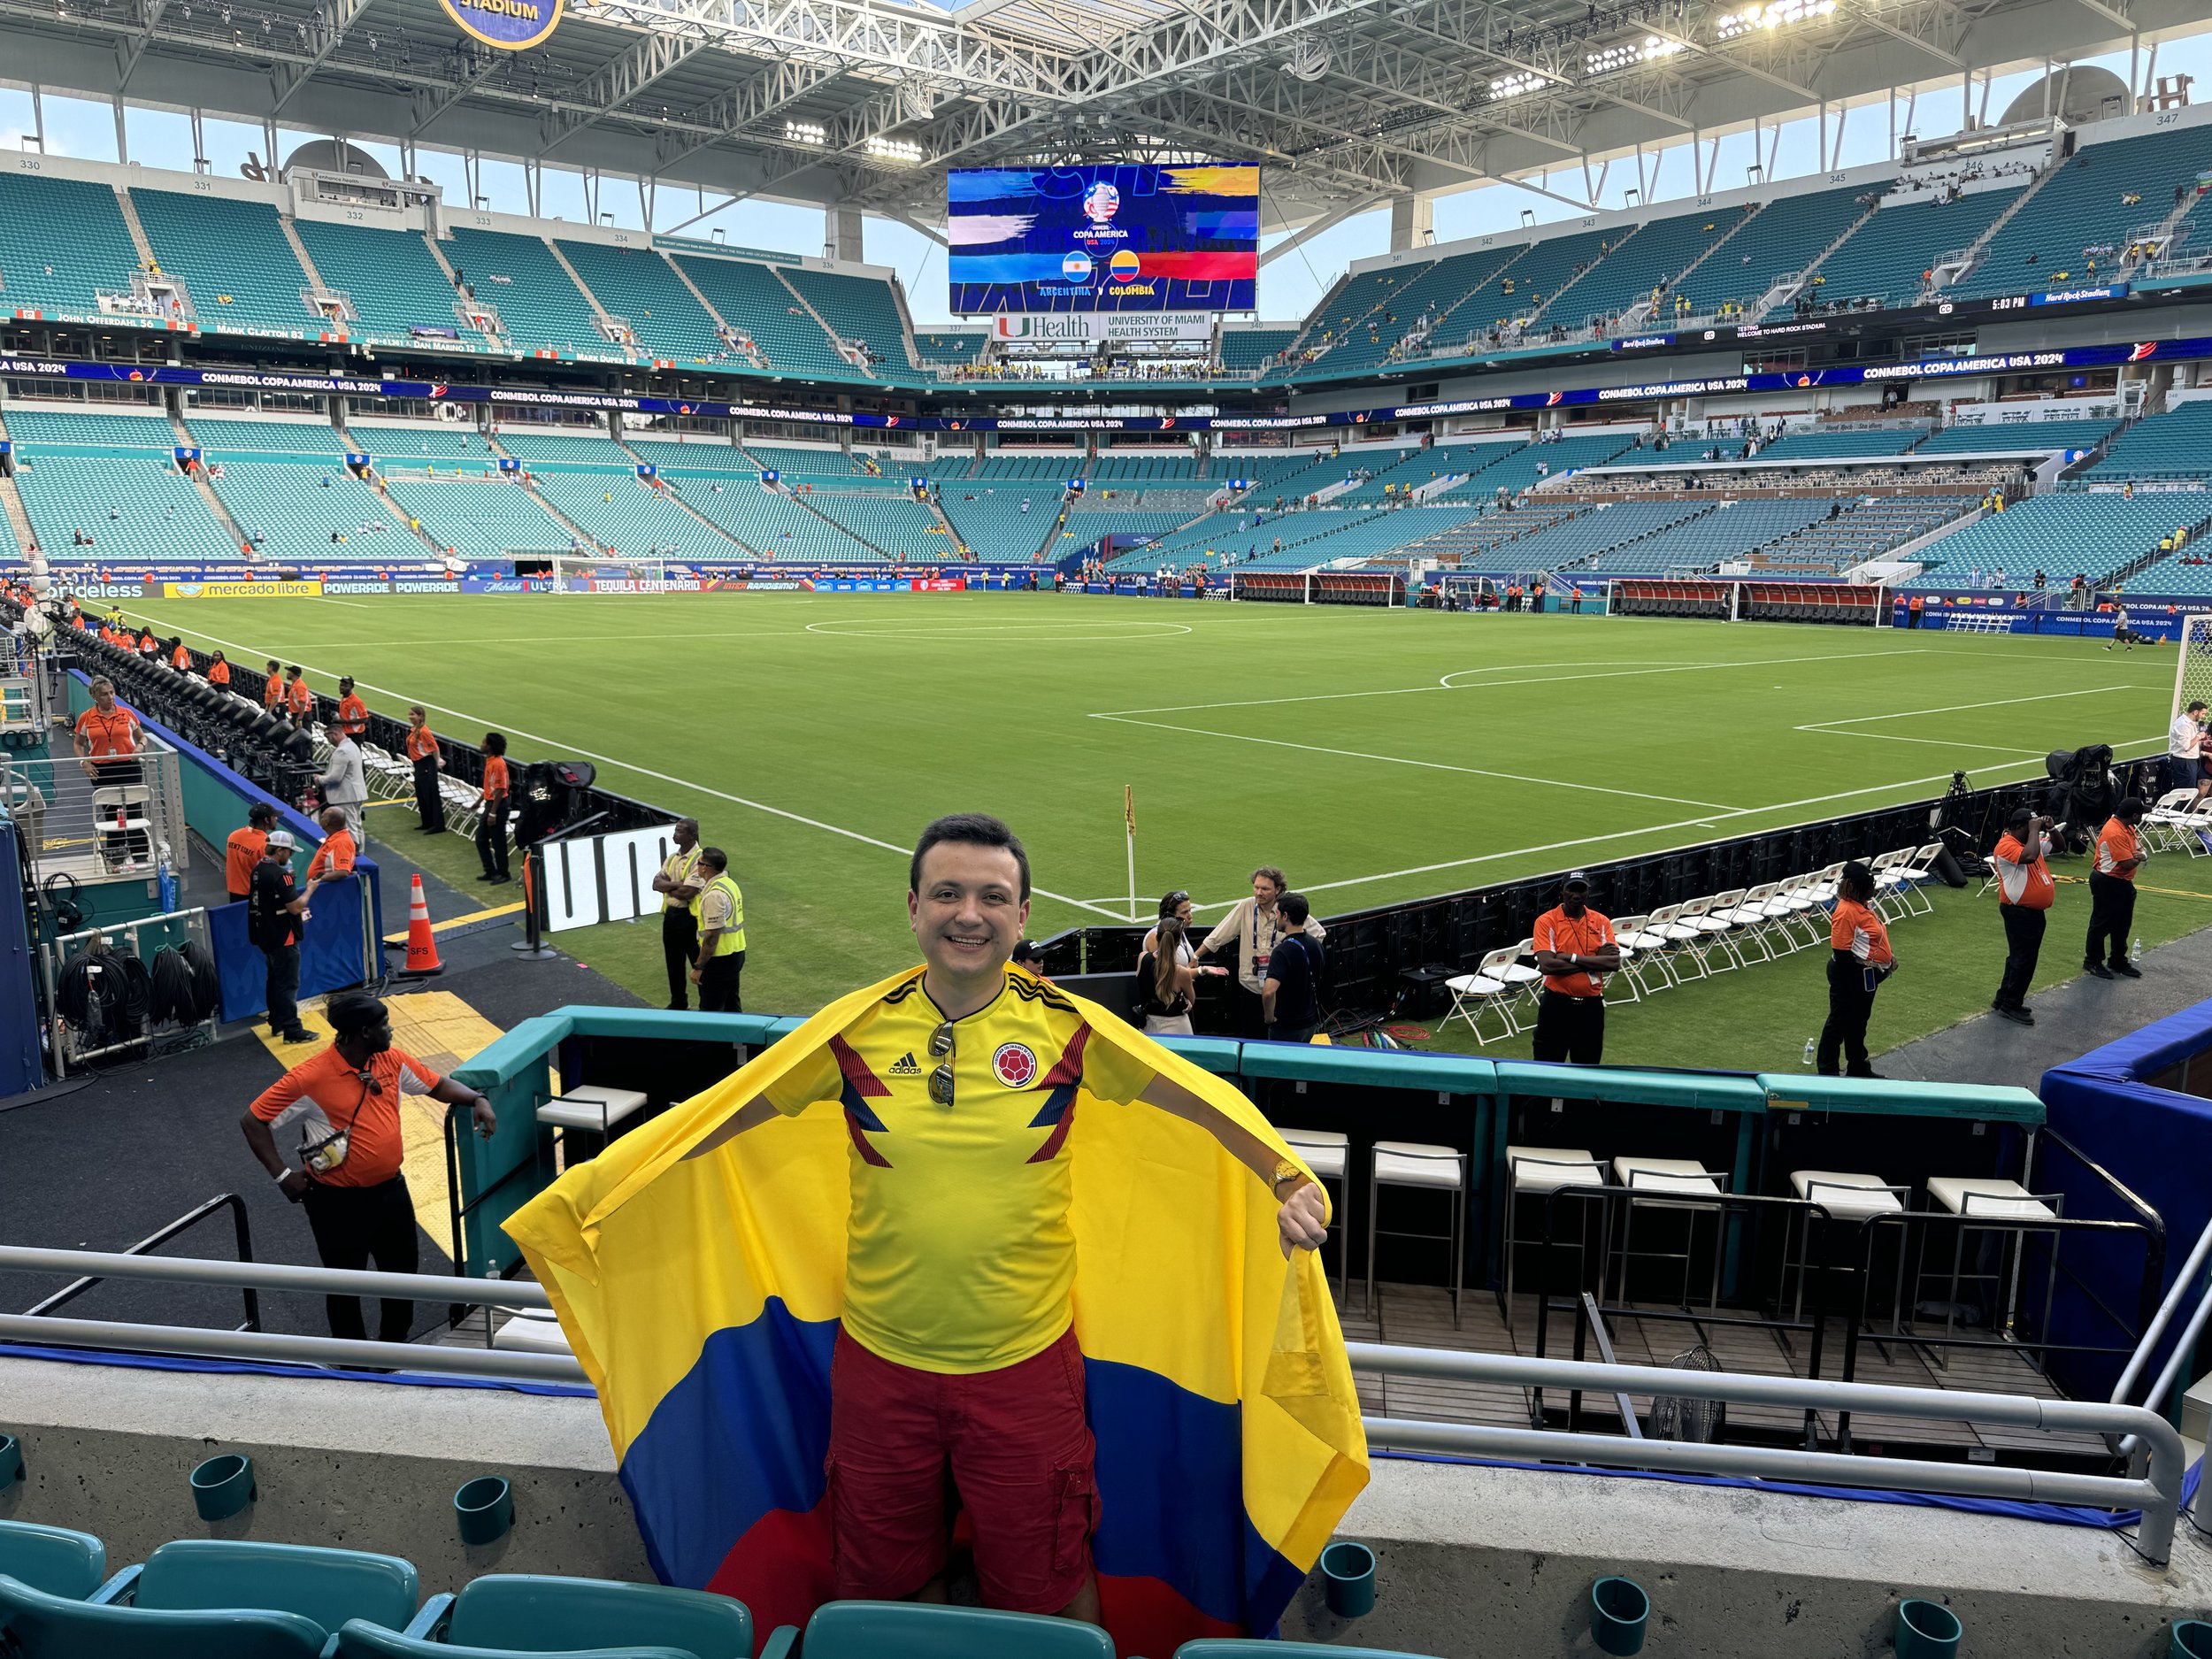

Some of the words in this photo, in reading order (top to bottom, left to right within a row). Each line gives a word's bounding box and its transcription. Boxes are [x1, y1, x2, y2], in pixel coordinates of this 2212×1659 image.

[2156, 113, 2178, 126] 347
[19, 159, 41, 171] 330
[1829, 173, 1847, 184] 345
[194, 180, 211, 191] 331
[1697, 197, 1713, 207] 344
[346, 211, 364, 220] 332
[475, 216, 491, 226] 333
[1582, 219, 1596, 227] 343
[1072, 230, 1094, 239] COPA
[1094, 229, 1129, 238] AMERICA
[1481, 237, 1494, 246] 342
[1109, 286, 1156, 296] COLOMBIA
[2045, 292, 2062, 302] Hard
[2062, 291, 2080, 302] Rock
[2079, 288, 2110, 298] Stadium
[1992, 299, 2010, 310] 5:03
[2012, 296, 2025, 308] PM
[56, 312, 84, 325] JOHN
[86, 314, 138, 328] OFFERDAHL
[140, 319, 154, 328] 56
[1108, 316, 1160, 326] UNIVERSITY
[1161, 315, 1173, 325] OF
[1174, 315, 1205, 325] MIAMI
[216, 325, 245, 335] MARK
[247, 326, 288, 338] CLAYTON
[290, 330, 304, 339] 83
[1108, 327, 1142, 337] HEALTH
[1143, 326, 1179, 337] SYSTEM
[1737, 329, 1763, 338] WELCOME
[413, 340, 431, 349] DAN
[433, 342, 464, 352] MARINO
[465, 343, 475, 353] 13
[576, 353, 599, 362] MARK
[600, 355, 625, 365] DUPER
[12, 361, 35, 372] USA
[37, 363, 66, 373] 2024
[1863, 364, 1924, 380] CONMEBOL
[1924, 361, 1955, 375] COPA
[1955, 357, 2007, 372] AMERICA
[2008, 355, 2032, 368] USA
[2033, 352, 2063, 366] 2024
[201, 373, 262, 386] CONMEBOL
[261, 376, 291, 388] COPA
[290, 378, 335, 390] AMERICA
[337, 380, 357, 391] USA
[357, 381, 381, 392] 2024
[1599, 387, 1644, 400] CONMEBOL
[1644, 386, 1669, 397] COPA
[1668, 382, 1706, 395] AMERICA
[1708, 380, 1724, 391] USA
[1725, 378, 1747, 389] 2024
[490, 390, 541, 403] CONMEBOL
[540, 394, 565, 404] COPA
[564, 396, 602, 406] AMERICA
[602, 397, 618, 407] USA
[618, 398, 639, 409] 2024
[729, 406, 771, 418] CONMEBOL
[771, 409, 790, 419] COPA
[789, 411, 822, 421] AMERICA
[822, 412, 836, 422] USA
[836, 413, 853, 423] 2024
[1394, 407, 1431, 418] CONMEBOL
[1430, 404, 1448, 415] COPA
[1448, 402, 1479, 412] AMERICA
[1479, 400, 1493, 410] USA
[1494, 399, 1510, 408] 2024
[996, 420, 1037, 429] CONMEBOL
[1037, 420, 1057, 429] COPA
[1057, 419, 1090, 429] AMERICA
[1105, 419, 1124, 429] 2024
[1210, 419, 1252, 427] CONMEBOL
[1252, 419, 1272, 427] COPA
[1272, 417, 1302, 426] AMERICA
[1312, 416, 1327, 425] 2024
[209, 583, 275, 595] mercado
[278, 582, 310, 595] libre
[324, 582, 390, 594] POWERADE
[396, 581, 460, 593] POWERADE
[594, 580, 636, 592] TEQUILA
[639, 580, 702, 592] CENTENARIO
[410, 947, 429, 956] SFS
[888, 1064, 922, 1075] adidas
